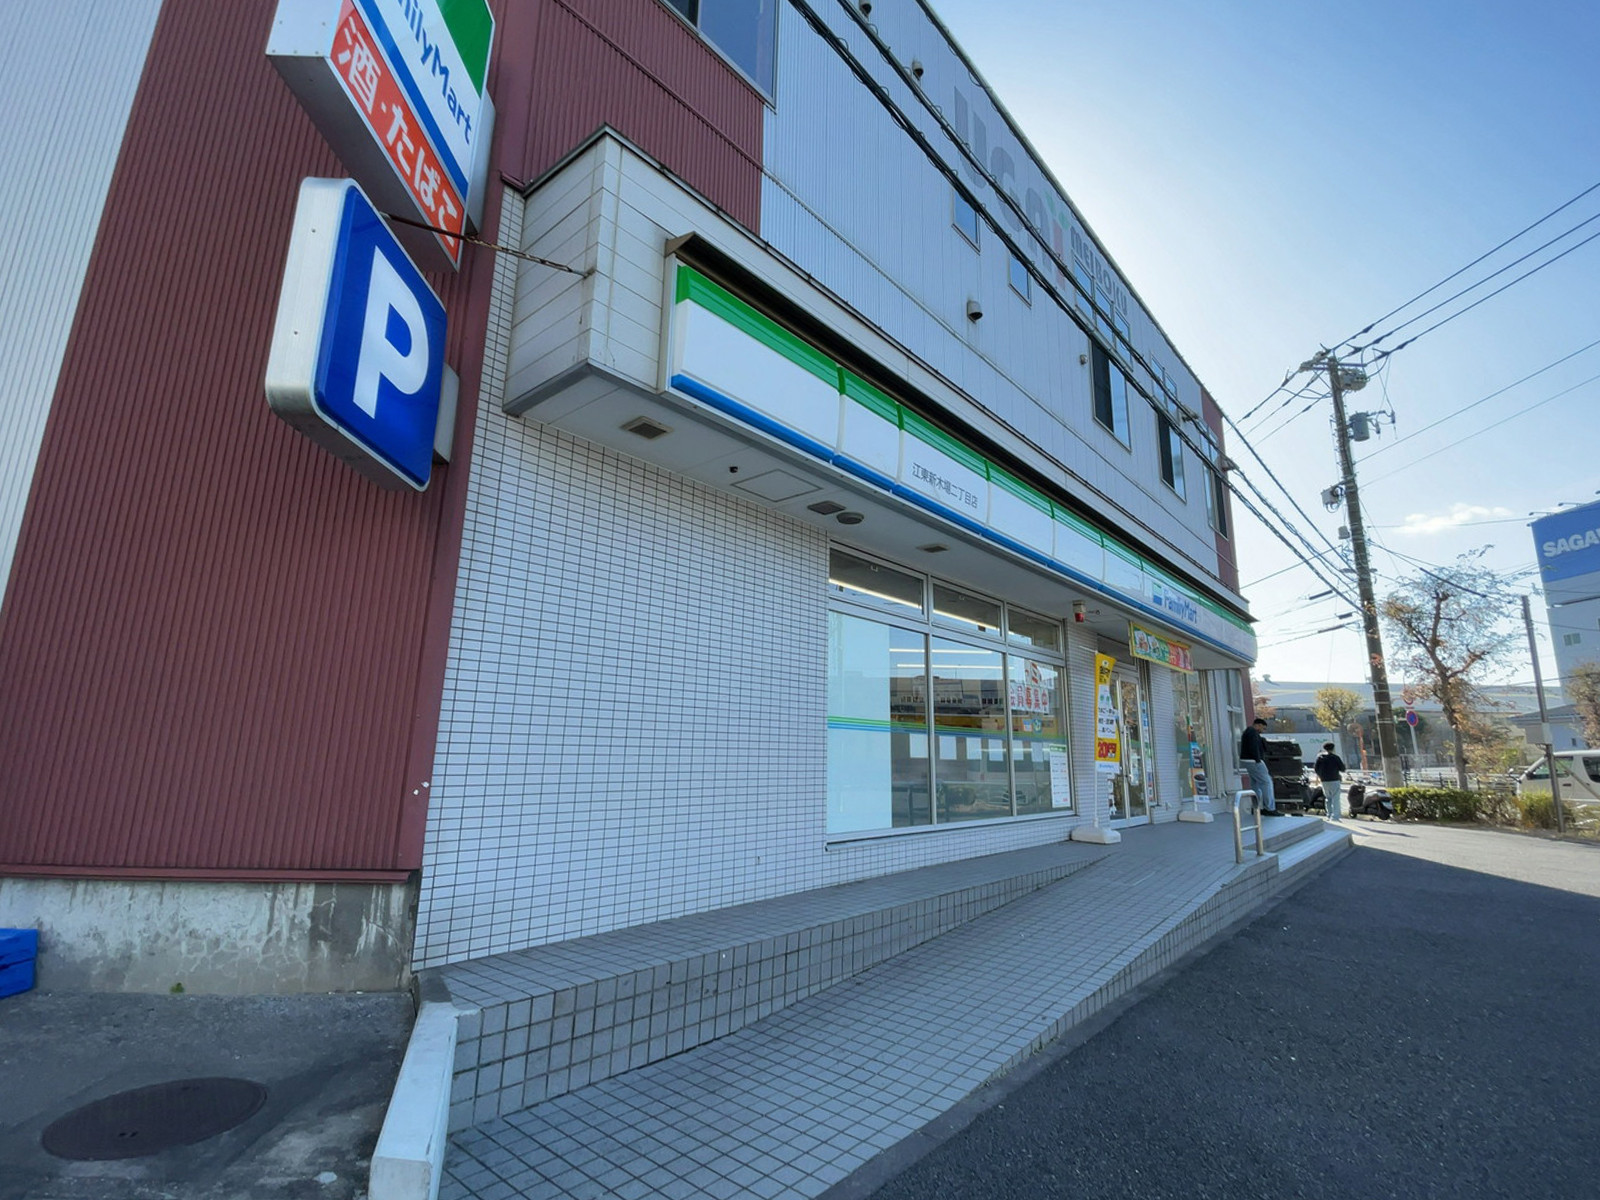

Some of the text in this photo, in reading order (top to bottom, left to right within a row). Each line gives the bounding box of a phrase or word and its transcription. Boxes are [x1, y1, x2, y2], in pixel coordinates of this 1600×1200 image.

[338, 16, 458, 247] 酒・たばこ
[353, 244, 429, 419] P
[911, 462, 978, 509] 江東新木場二丁目店
[1543, 528, 1600, 557] SAGA
[1164, 594, 1197, 624] FamilyMart
